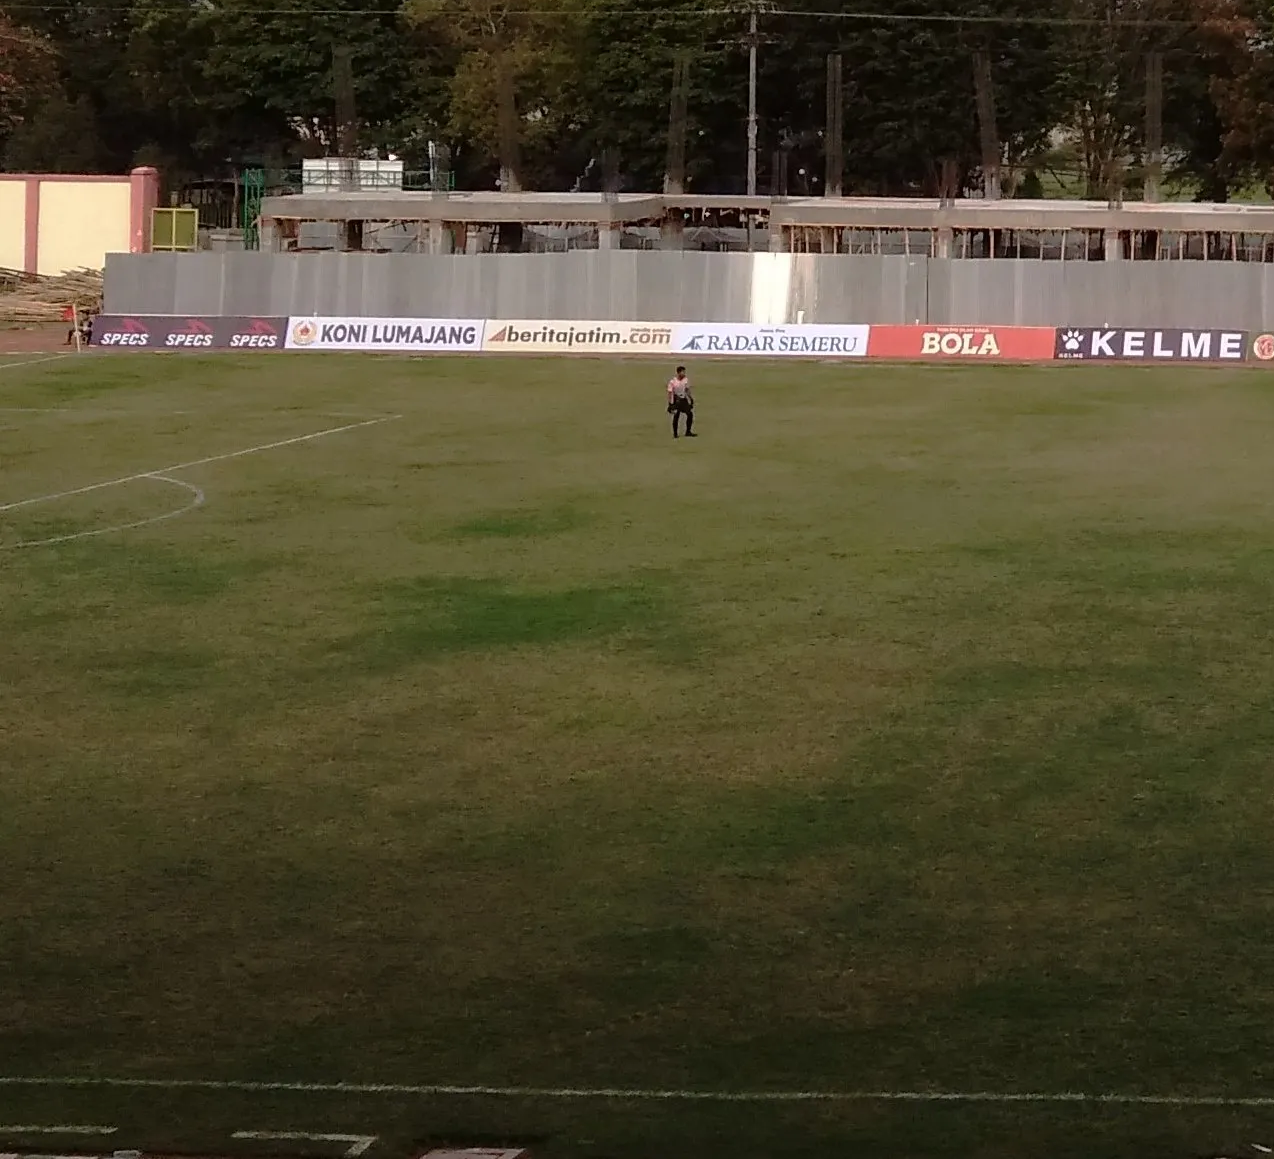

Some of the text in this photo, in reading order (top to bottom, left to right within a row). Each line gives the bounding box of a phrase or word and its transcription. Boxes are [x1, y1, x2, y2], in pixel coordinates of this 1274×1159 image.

[100, 333, 149, 346] SPECS
[165, 334, 213, 347] SPECS
[229, 335, 278, 347] SPECS
[320, 324, 476, 345] KONI LUMAJANG
[507, 325, 671, 346] beritajatim.com
[707, 335, 857, 353] RADAR SEMERU
[920, 332, 1001, 355] BOLA
[1091, 331, 1242, 358] KELME
